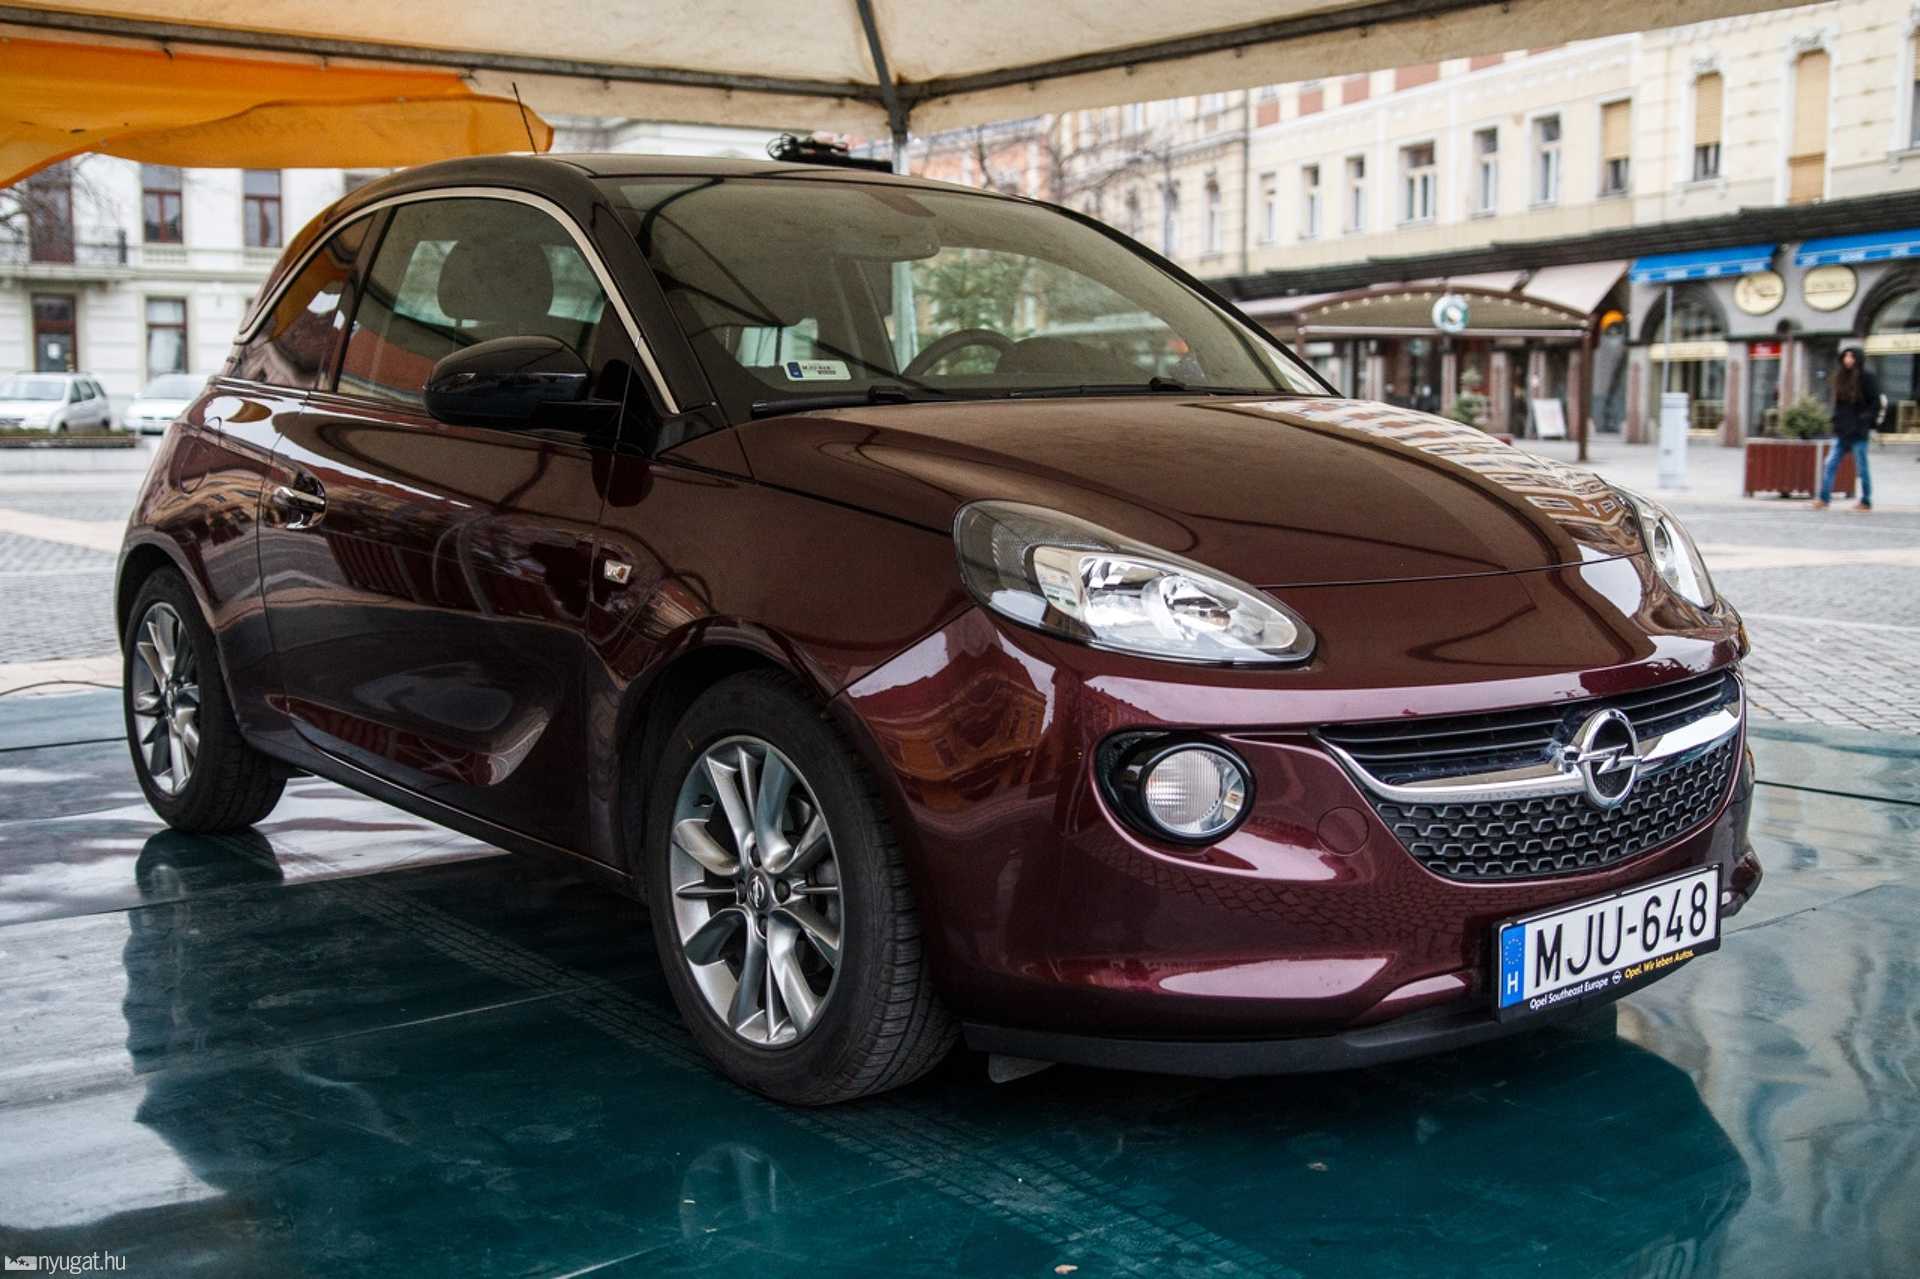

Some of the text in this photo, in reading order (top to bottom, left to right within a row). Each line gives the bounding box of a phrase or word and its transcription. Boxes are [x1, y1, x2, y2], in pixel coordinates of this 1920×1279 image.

[1535, 881, 1708, 988] MJU-648
[1507, 971, 1518, 995] H
[1529, 976, 1609, 1010] Opel Southeast Europe
